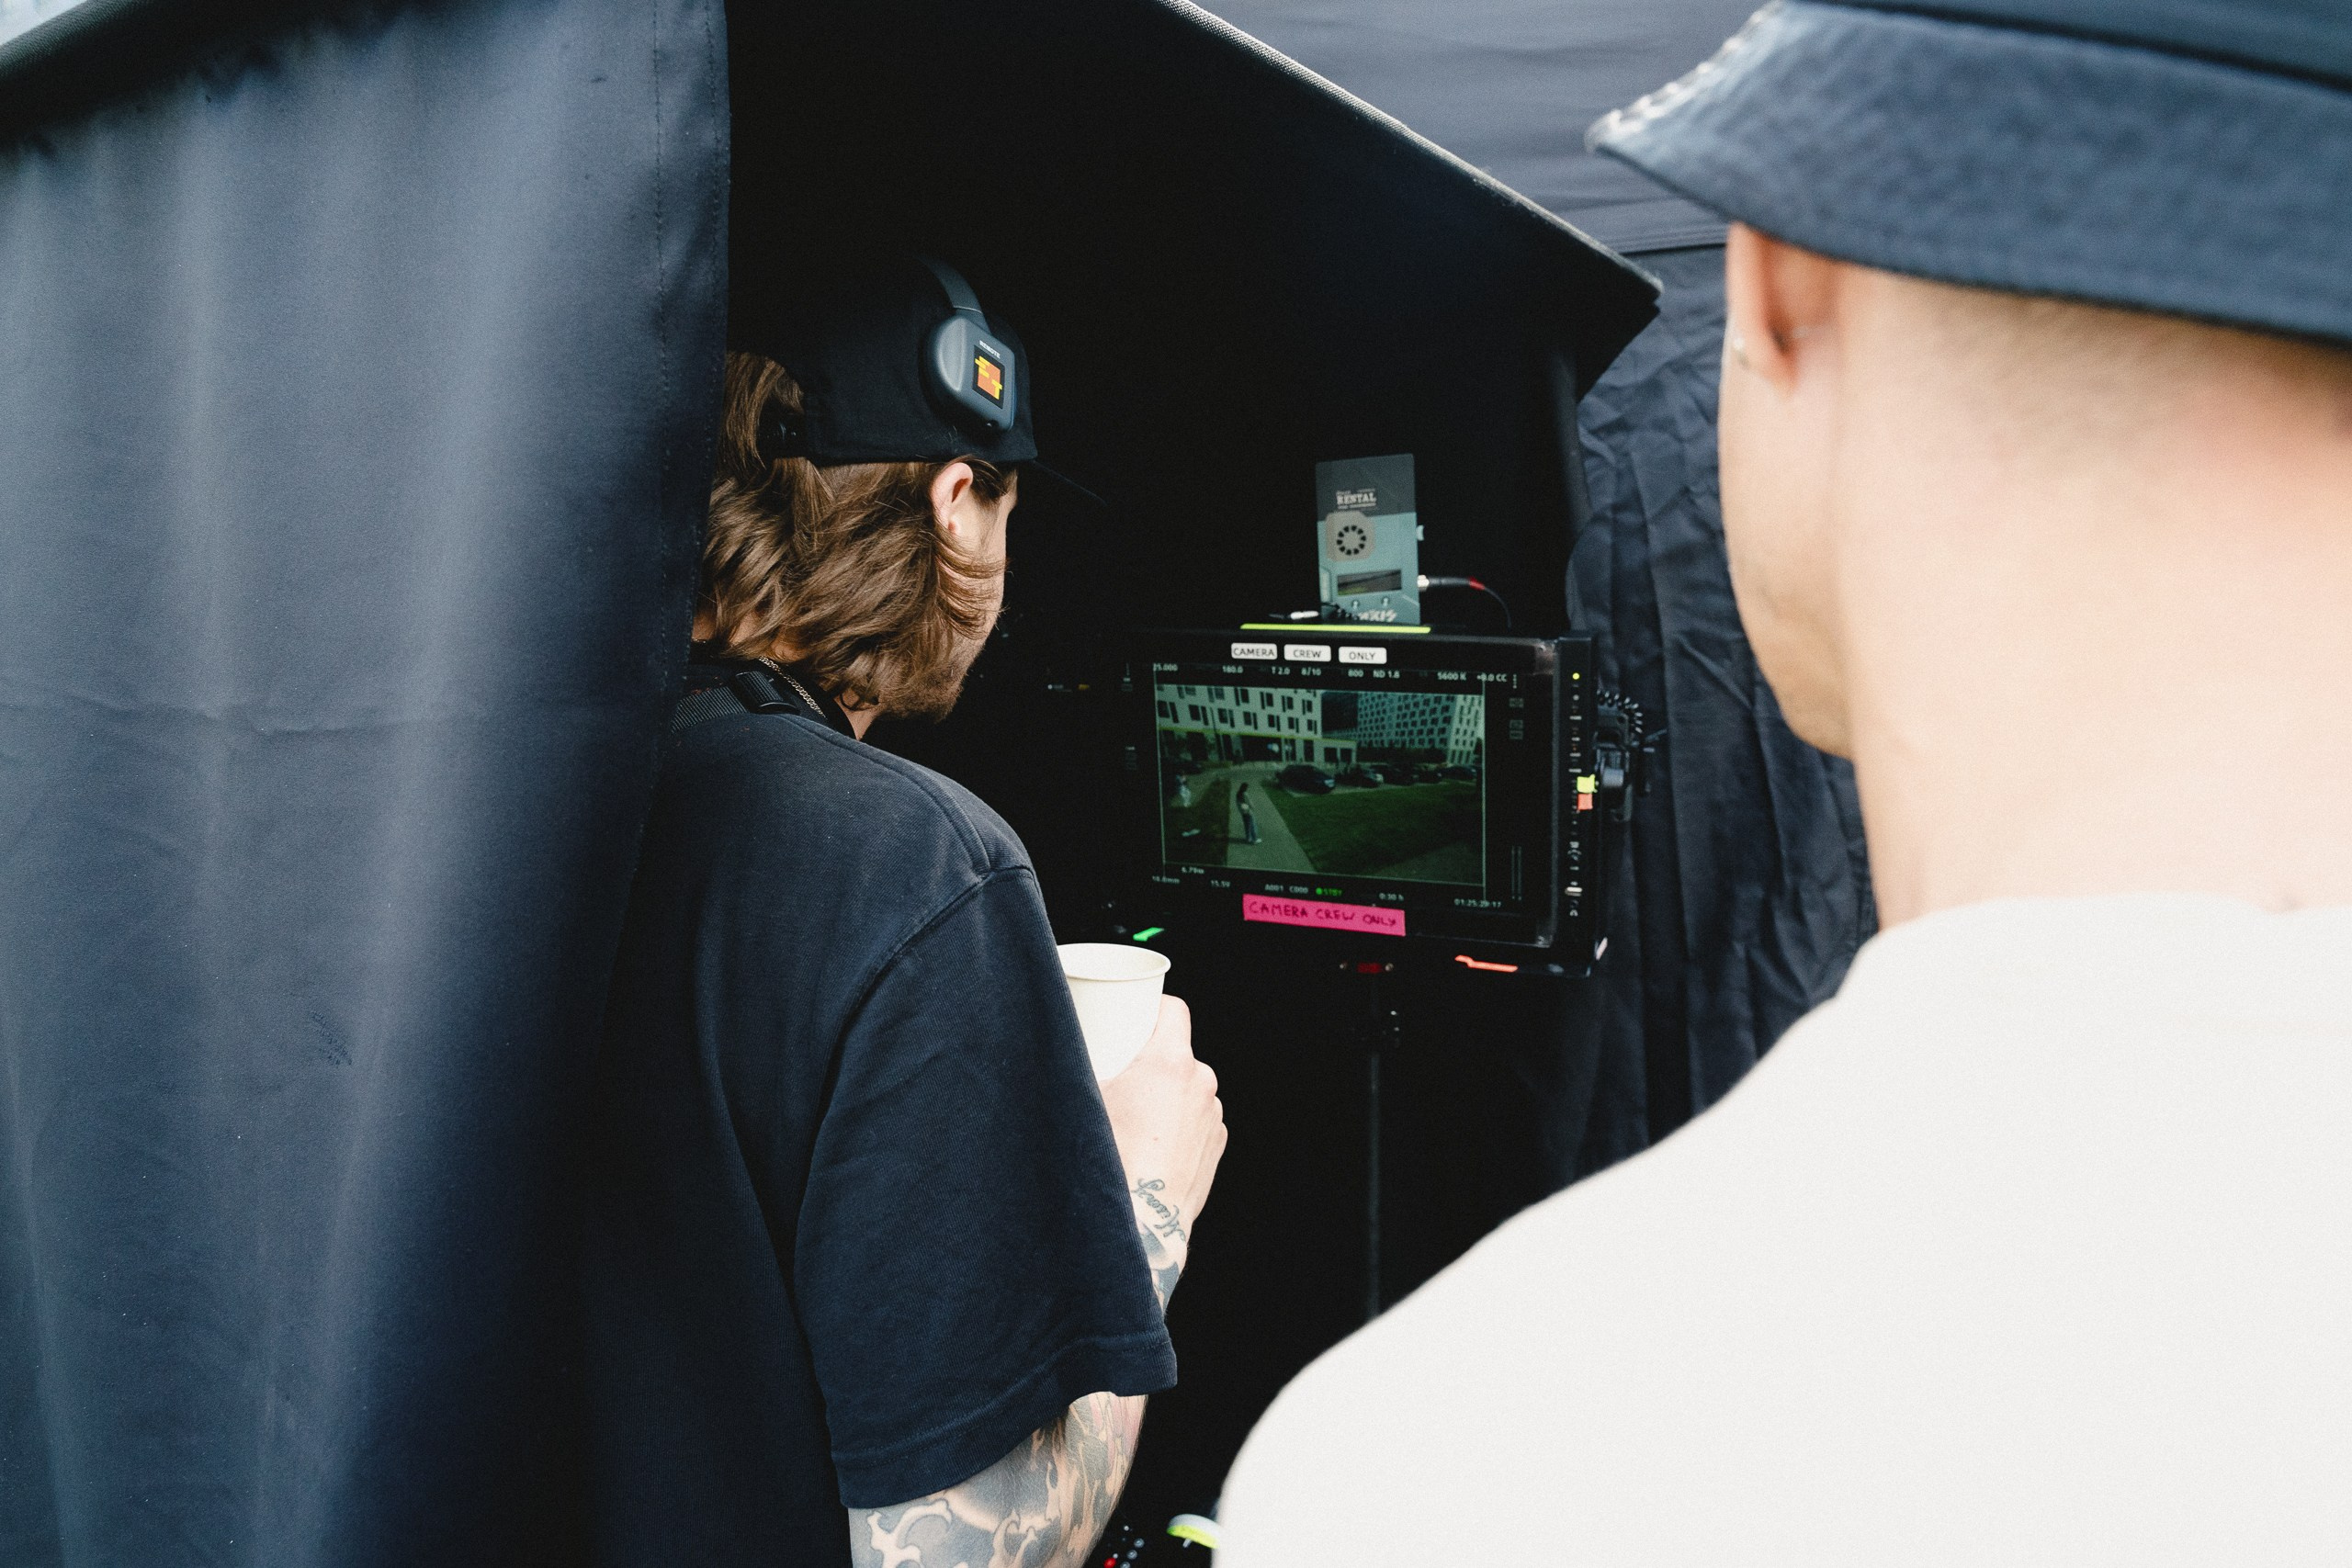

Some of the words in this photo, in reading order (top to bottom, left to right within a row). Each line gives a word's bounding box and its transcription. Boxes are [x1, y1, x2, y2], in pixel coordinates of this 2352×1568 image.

[978, 340, 1001, 359] REMOTE
[1233, 647, 1275, 658] CAMERA
[1293, 649, 1322, 660] CREW
[1348, 650, 1377, 661] ONLY
[1250, 900, 1309, 919] CAMERA
[1315, 908, 1355, 921] CREW
[1363, 914, 1396, 928] ONLY
